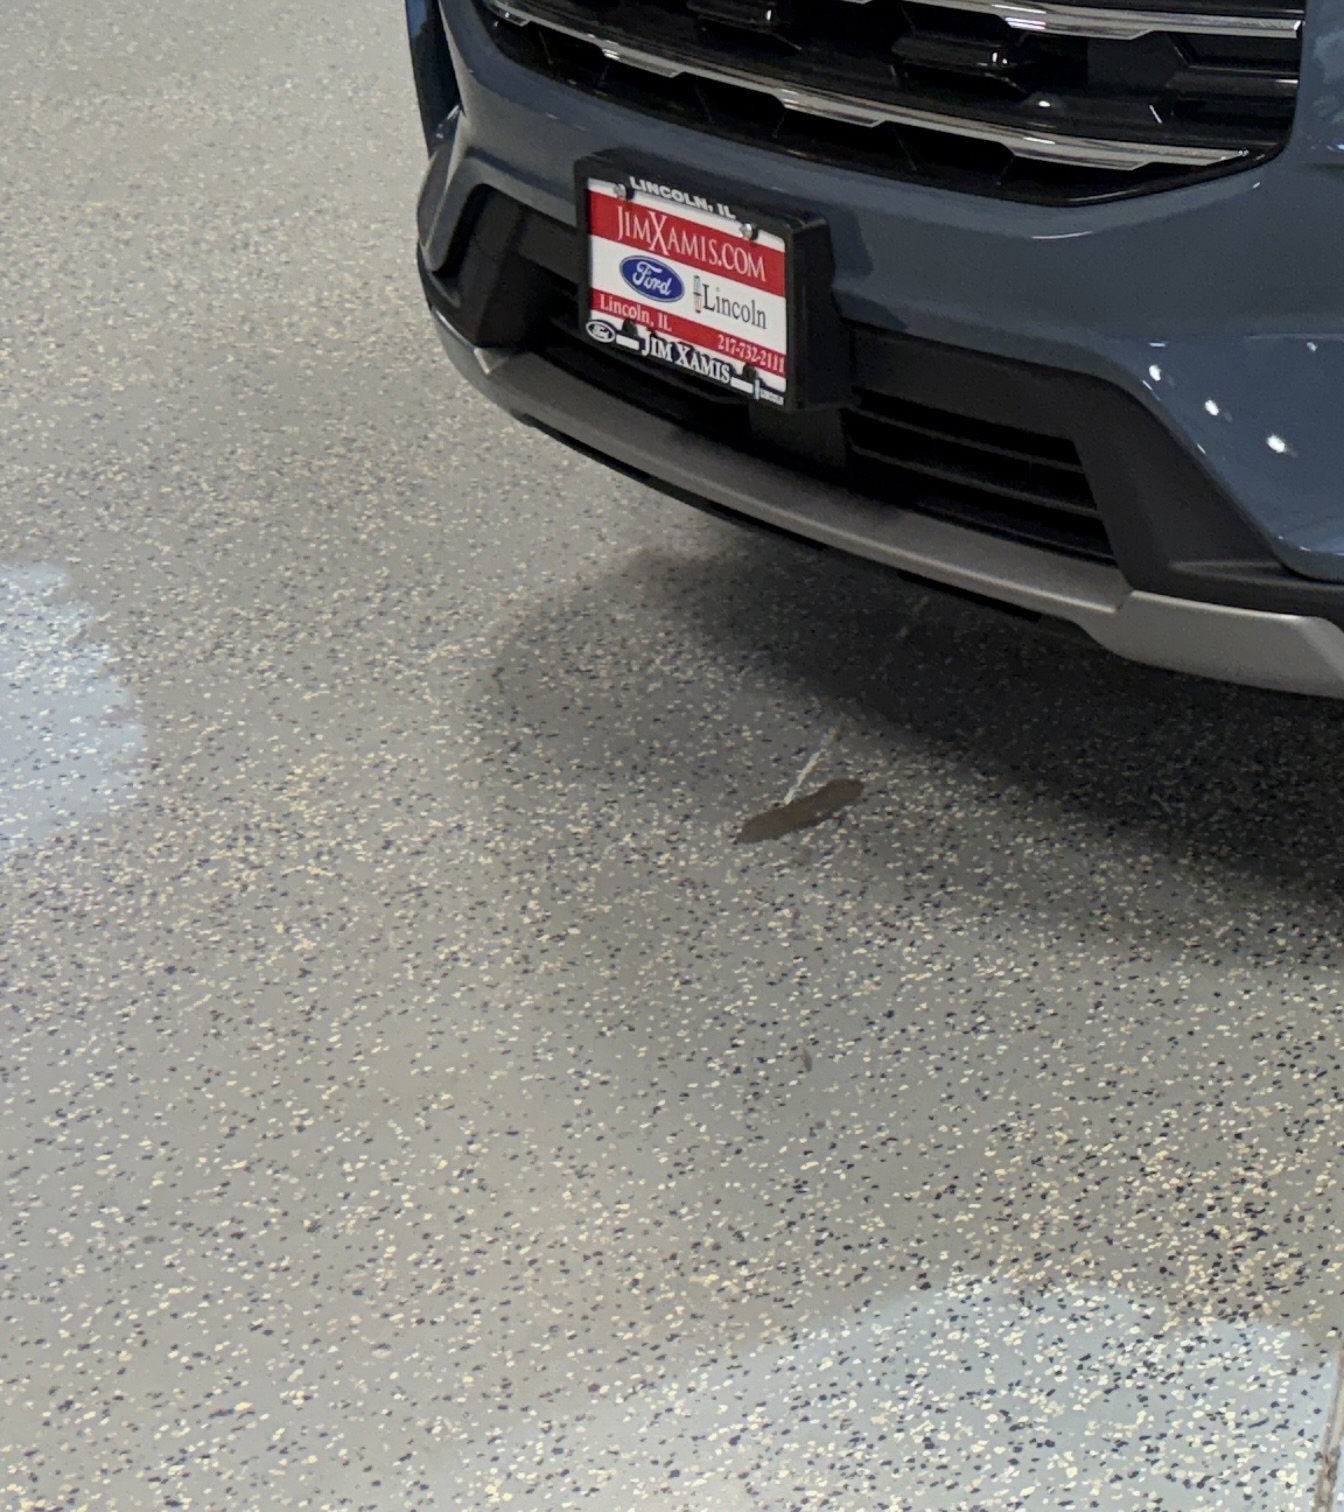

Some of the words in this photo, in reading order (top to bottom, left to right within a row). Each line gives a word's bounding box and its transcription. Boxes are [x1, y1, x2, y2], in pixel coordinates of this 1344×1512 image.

[629, 175, 714, 212] LINCOLN,
[717, 202, 736, 220] IL
[616, 205, 767, 282] JIMXAMIS.COM
[631, 260, 673, 297] Ford
[657, 313, 673, 332] IL
[701, 283, 768, 330] Lincoln
[641, 333, 672, 361] JIM
[674, 343, 731, 384] XAMIS
[717, 333, 785, 374] 217-732-2111
